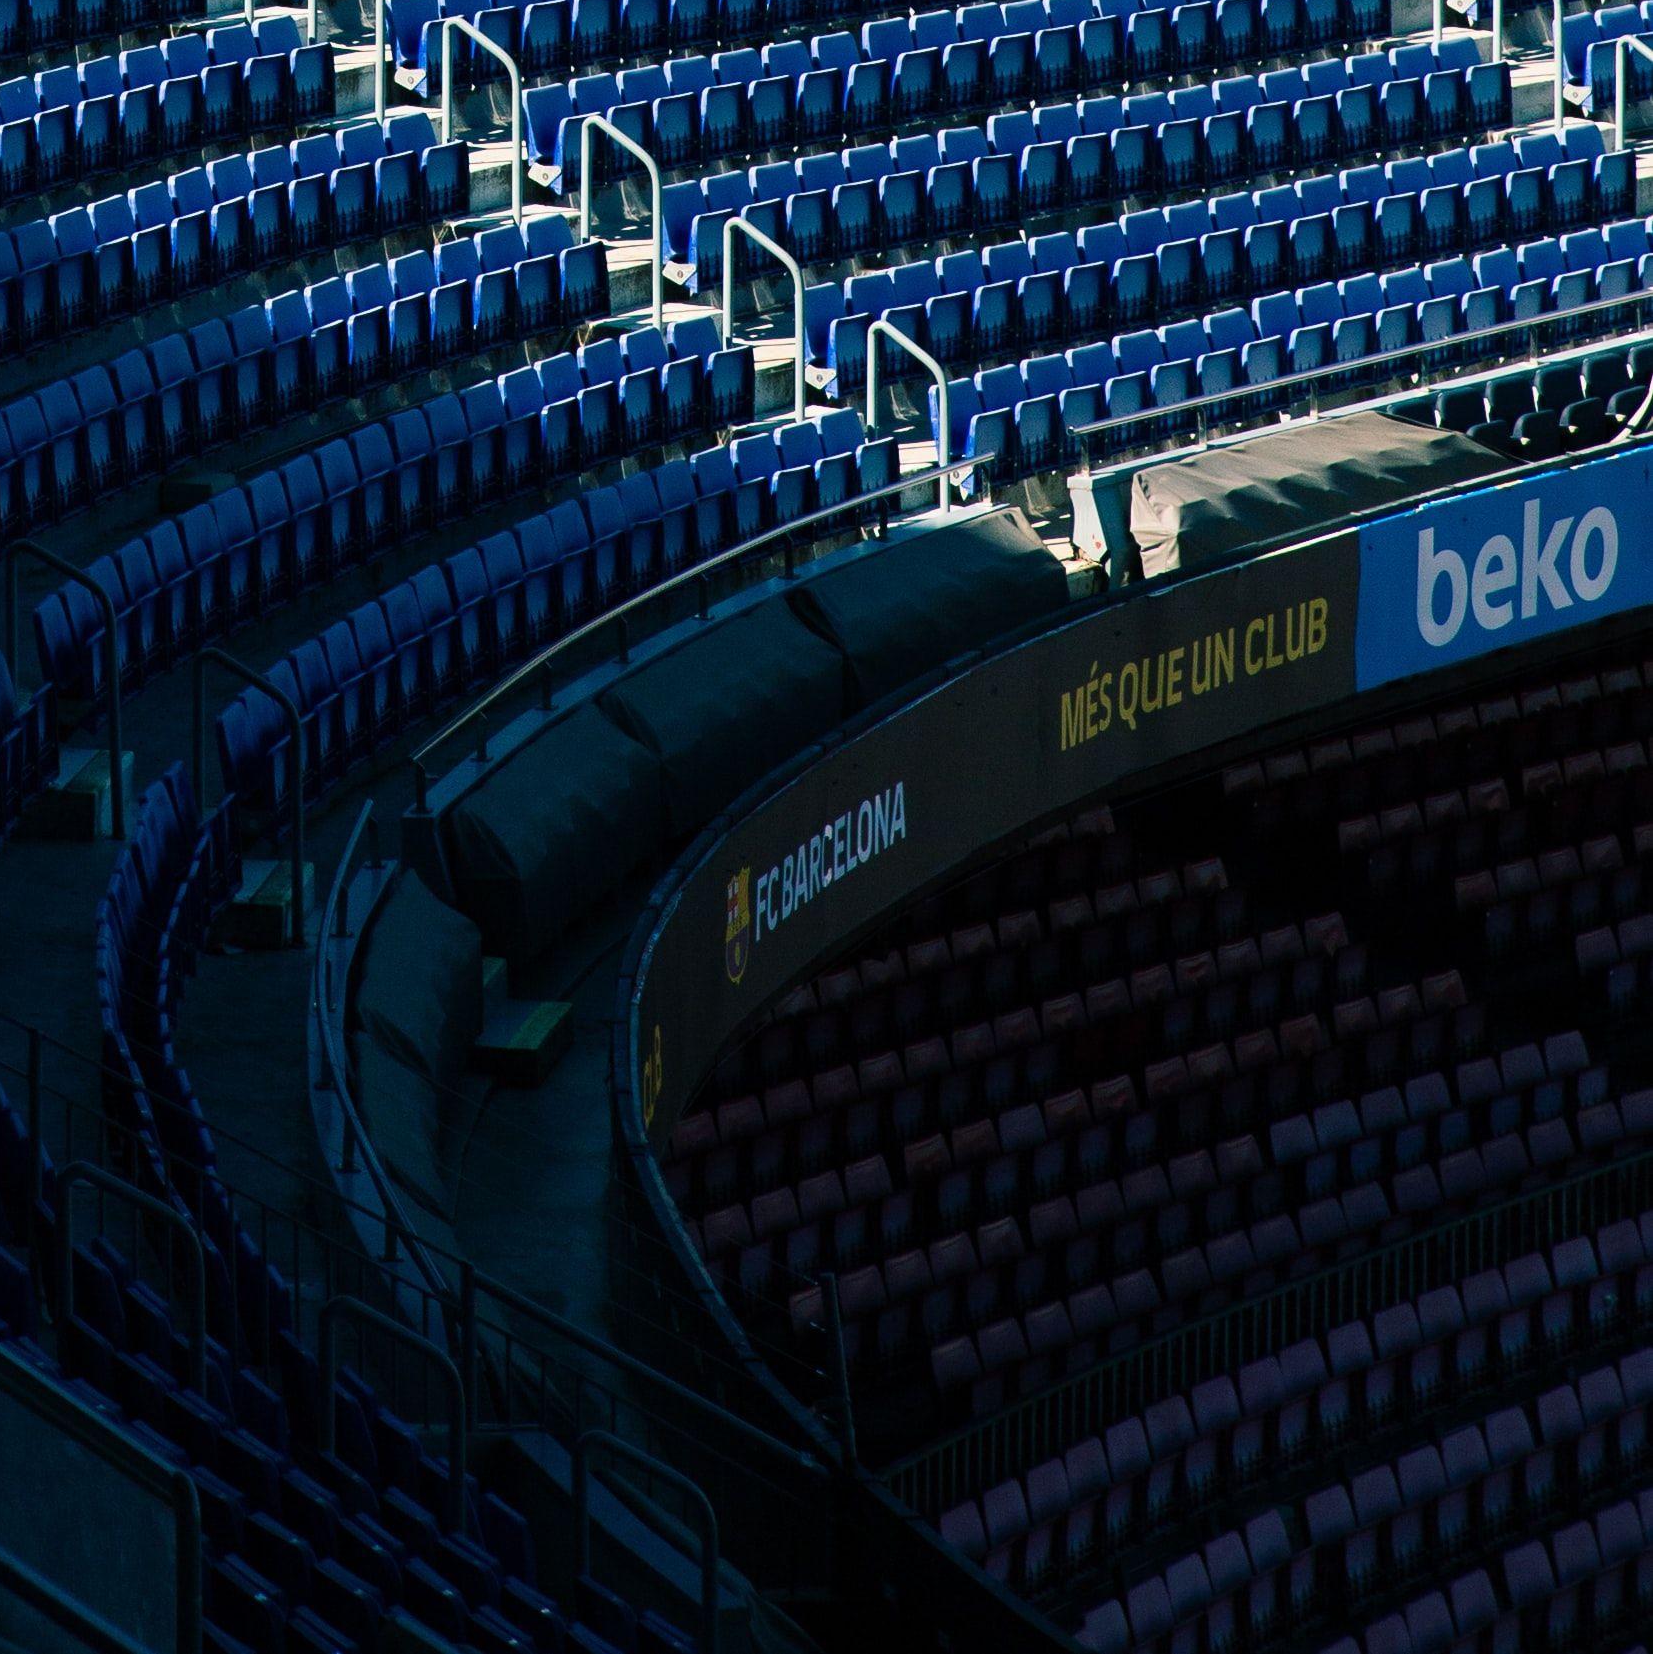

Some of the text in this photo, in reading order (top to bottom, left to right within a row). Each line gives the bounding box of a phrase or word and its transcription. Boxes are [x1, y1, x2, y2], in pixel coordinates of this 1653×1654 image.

[1417, 497, 1620, 648] beko
[1059, 596, 1329, 751] MÉS QUE UN CLUB
[754, 781, 906, 943] FC BARCELONA
